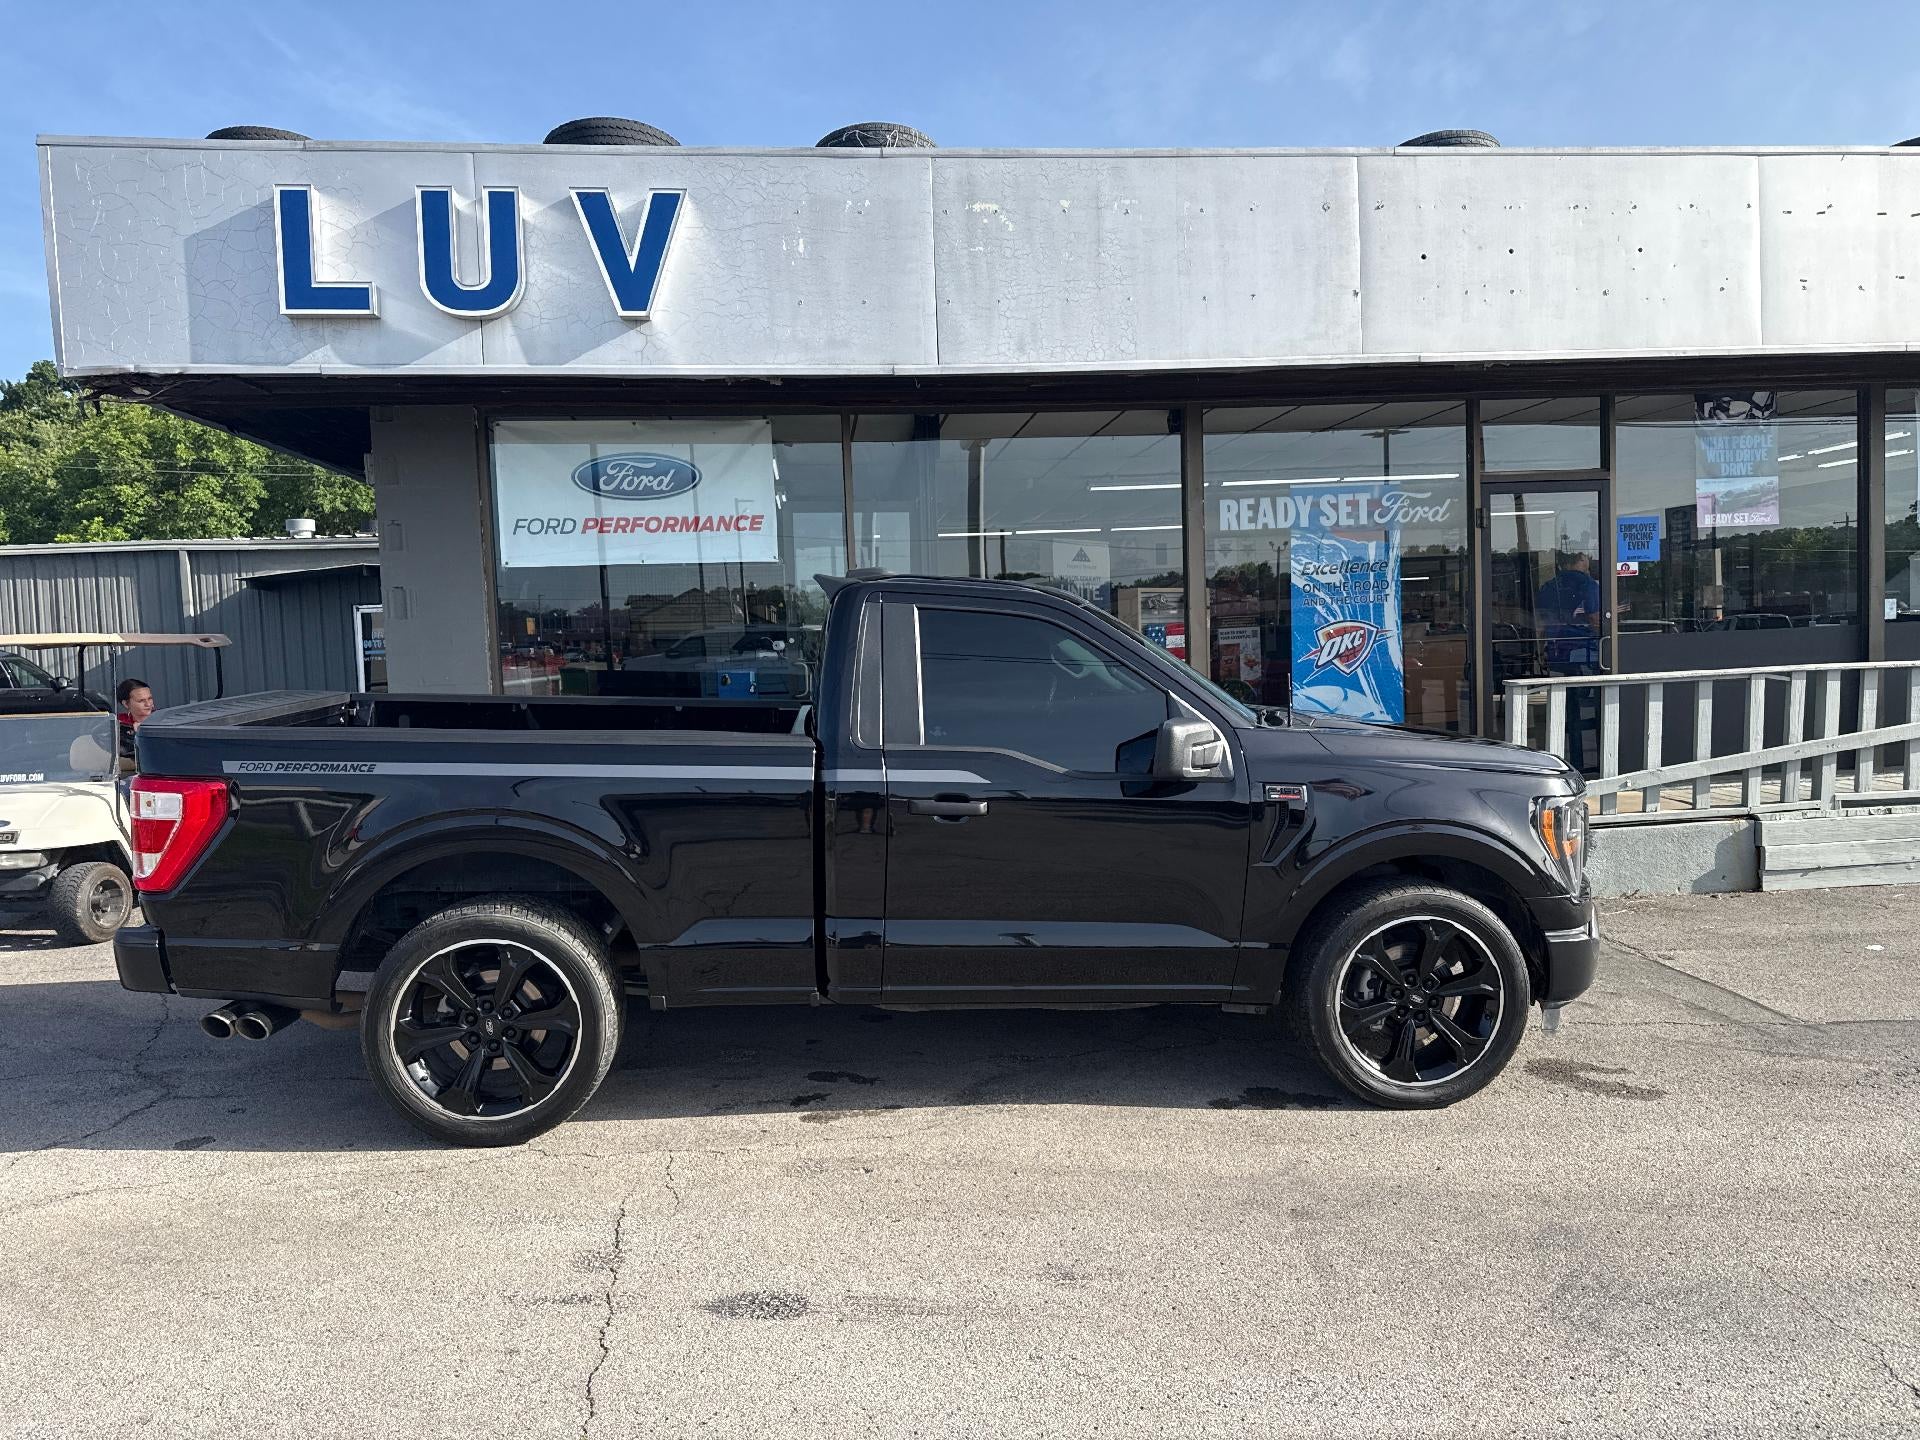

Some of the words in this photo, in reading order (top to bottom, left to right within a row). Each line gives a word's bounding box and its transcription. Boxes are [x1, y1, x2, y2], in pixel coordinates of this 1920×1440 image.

[274, 183, 687, 320] LUV
[1733, 434, 1773, 449] PEOPLE
[1706, 448, 1733, 462] WITH
[1736, 447, 1768, 462] DRIVE
[599, 460, 675, 491] Ford
[1720, 462, 1754, 476] DRIVE
[1219, 496, 1314, 531] READY
[1319, 493, 1371, 527] SET
[1374, 491, 1449, 523] Ford
[512, 518, 577, 536] FORD
[580, 514, 765, 535] PERFORMANCE
[1704, 513, 1732, 525] READY
[1733, 512, 1750, 524] SET
[1620, 523, 1657, 532] EMPLOYEE
[1623, 532, 1653, 541] PRICING
[1628, 541, 1650, 551] EVENT
[1301, 560, 1389, 576] Excellence
[1302, 584, 1323, 594] ON
[1325, 582, 1350, 593] THE
[1354, 580, 1390, 592] ROAD
[1303, 597, 1326, 607] AND
[1330, 596, 1352, 605] THE
[1354, 594, 1390, 605] COURT
[1318, 630, 1364, 666] OKC
[238, 762, 273, 772] FORD
[274, 763, 376, 773] PERFORMANCE
